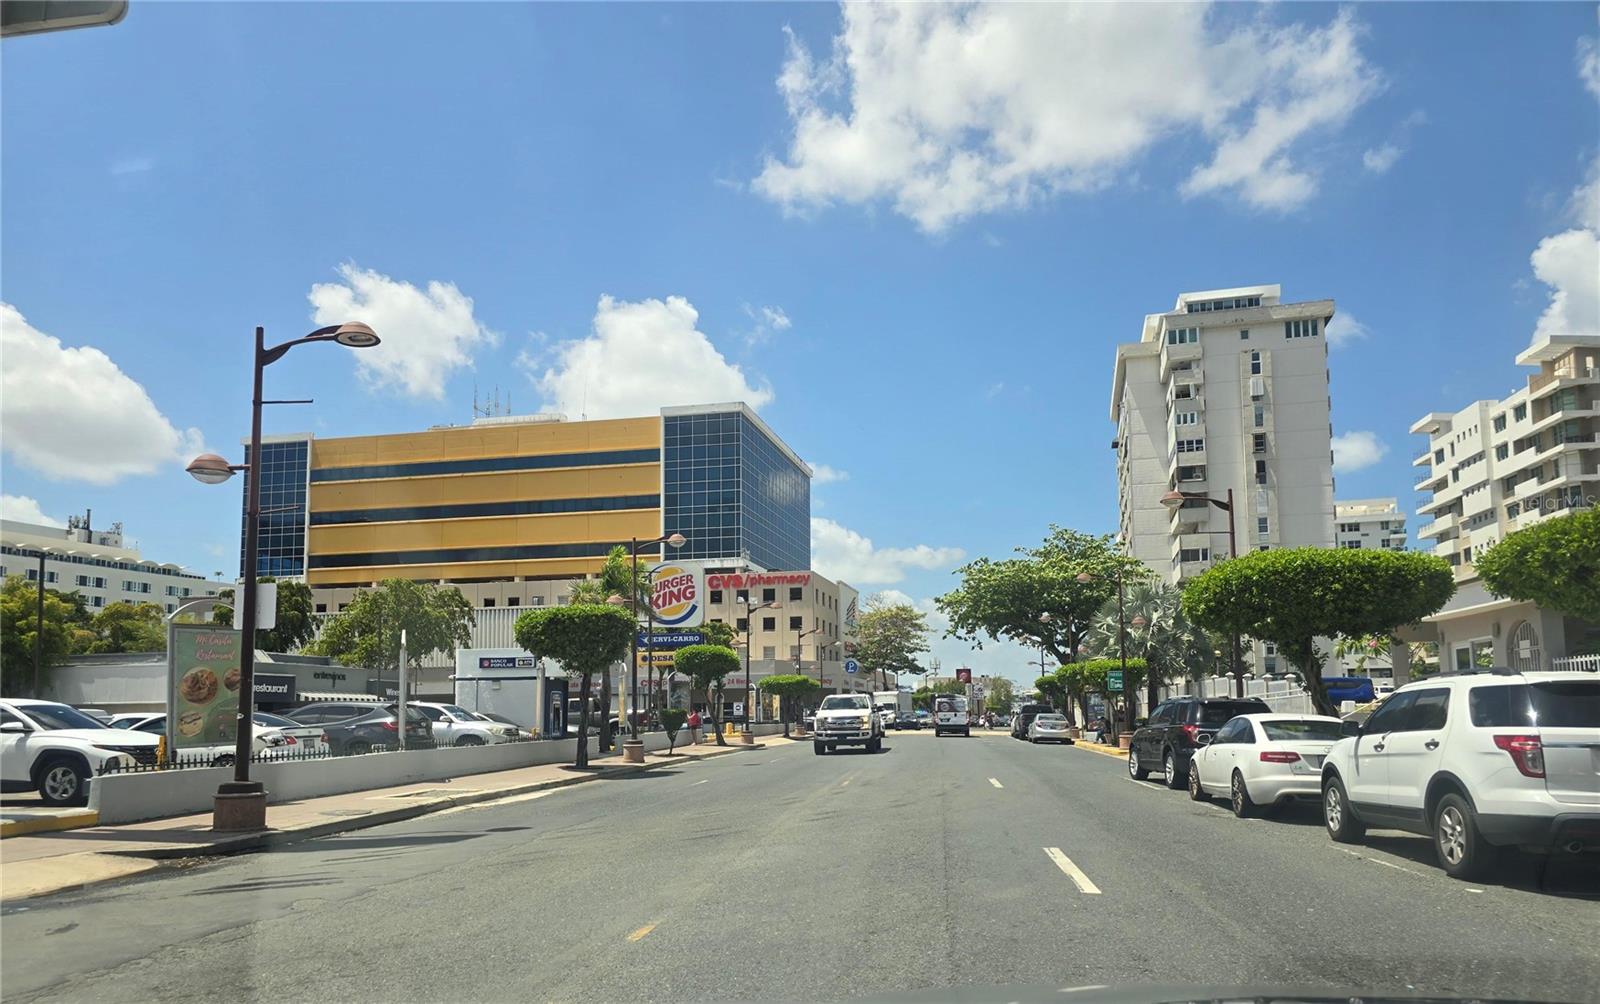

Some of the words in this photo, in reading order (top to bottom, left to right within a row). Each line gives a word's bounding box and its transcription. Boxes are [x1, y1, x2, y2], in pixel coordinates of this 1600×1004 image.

[653, 574, 694, 594] URGER
[708, 574, 811, 591] CVS/pharmacy
[649, 585, 696, 610] KING
